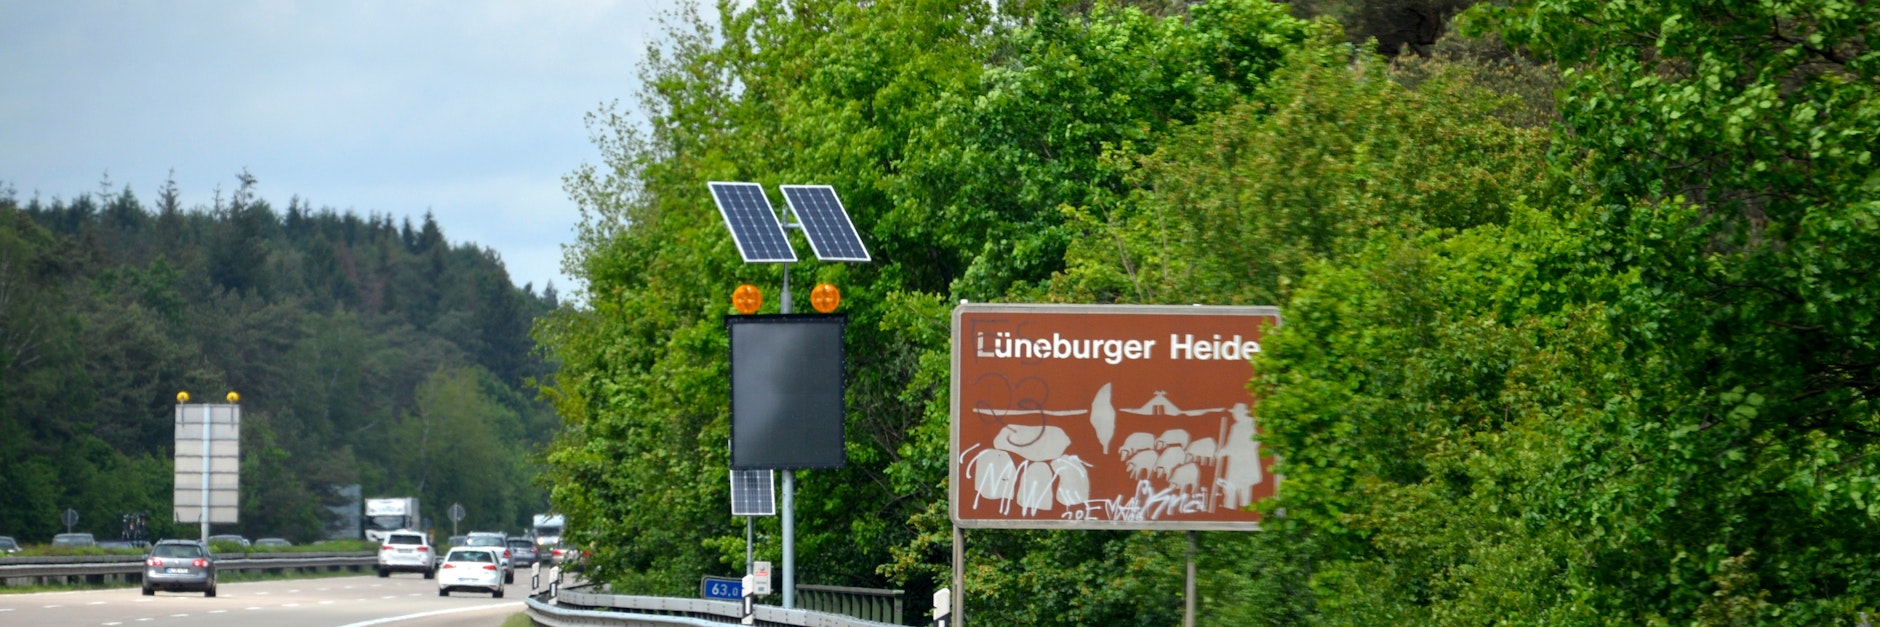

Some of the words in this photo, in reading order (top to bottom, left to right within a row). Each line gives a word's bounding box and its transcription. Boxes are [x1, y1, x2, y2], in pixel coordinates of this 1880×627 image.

[976, 331, 1156, 364] Lüneburger
[1169, 333, 1261, 360] Heide
[711, 583, 739, 597] 63.0
